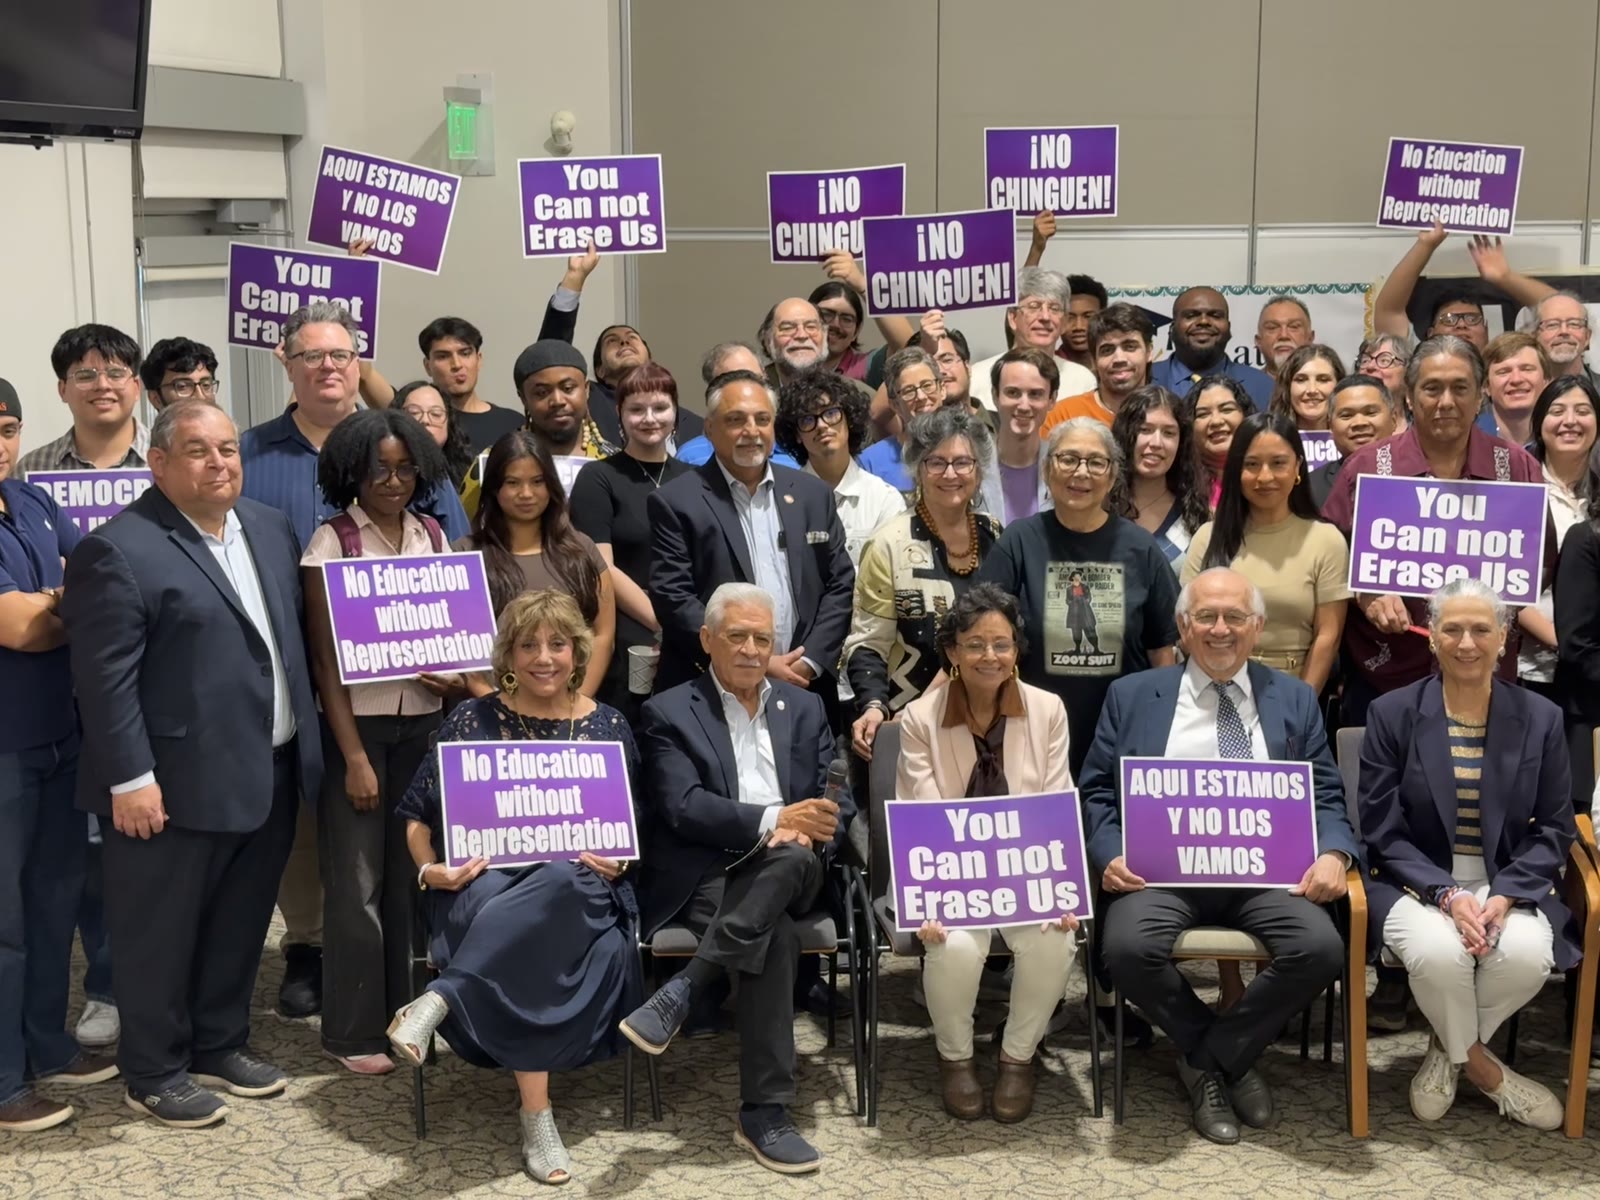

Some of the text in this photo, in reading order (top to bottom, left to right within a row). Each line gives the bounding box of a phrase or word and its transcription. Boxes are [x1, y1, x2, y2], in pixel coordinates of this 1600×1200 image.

[1401, 143, 1507, 175] No Education
[322, 154, 452, 205] AQUI ESTAMOS
[562, 164, 619, 191] You
[990, 175, 1111, 211] CHINGUEN!
[1418, 173, 1481, 200] without
[342, 189, 417, 227] Y NO LOS
[534, 192, 650, 221] Can not
[1382, 195, 1510, 228] Representation
[341, 220, 404, 256] VAMOS
[529, 220, 658, 250] Erase Us
[775, 219, 863, 257] CHINGU
[274, 255, 332, 289] You
[871, 261, 1011, 310] CHINGUEN!
[240, 281, 300, 315] Can
[234, 311, 286, 344] Era
[1415, 486, 1487, 522] You
[1370, 517, 1525, 559] Can not
[342, 560, 470, 598] No Education
[1358, 552, 1530, 596] Erase Us
[374, 598, 453, 634] without
[340, 629, 494, 674] Representation
[1053, 654, 1115, 666] ZOOT SUIT
[460, 748, 607, 782] No Education
[1129, 767, 1306, 800] AQUI ESTAMOS
[494, 784, 584, 818] without
[451, 817, 631, 859] Representation
[944, 808, 1021, 842] You
[1167, 807, 1272, 837] Y NO LOS
[908, 839, 1067, 881] Can not
[1177, 846, 1266, 876] VAMOS
[903, 877, 1080, 921] Erase Us
